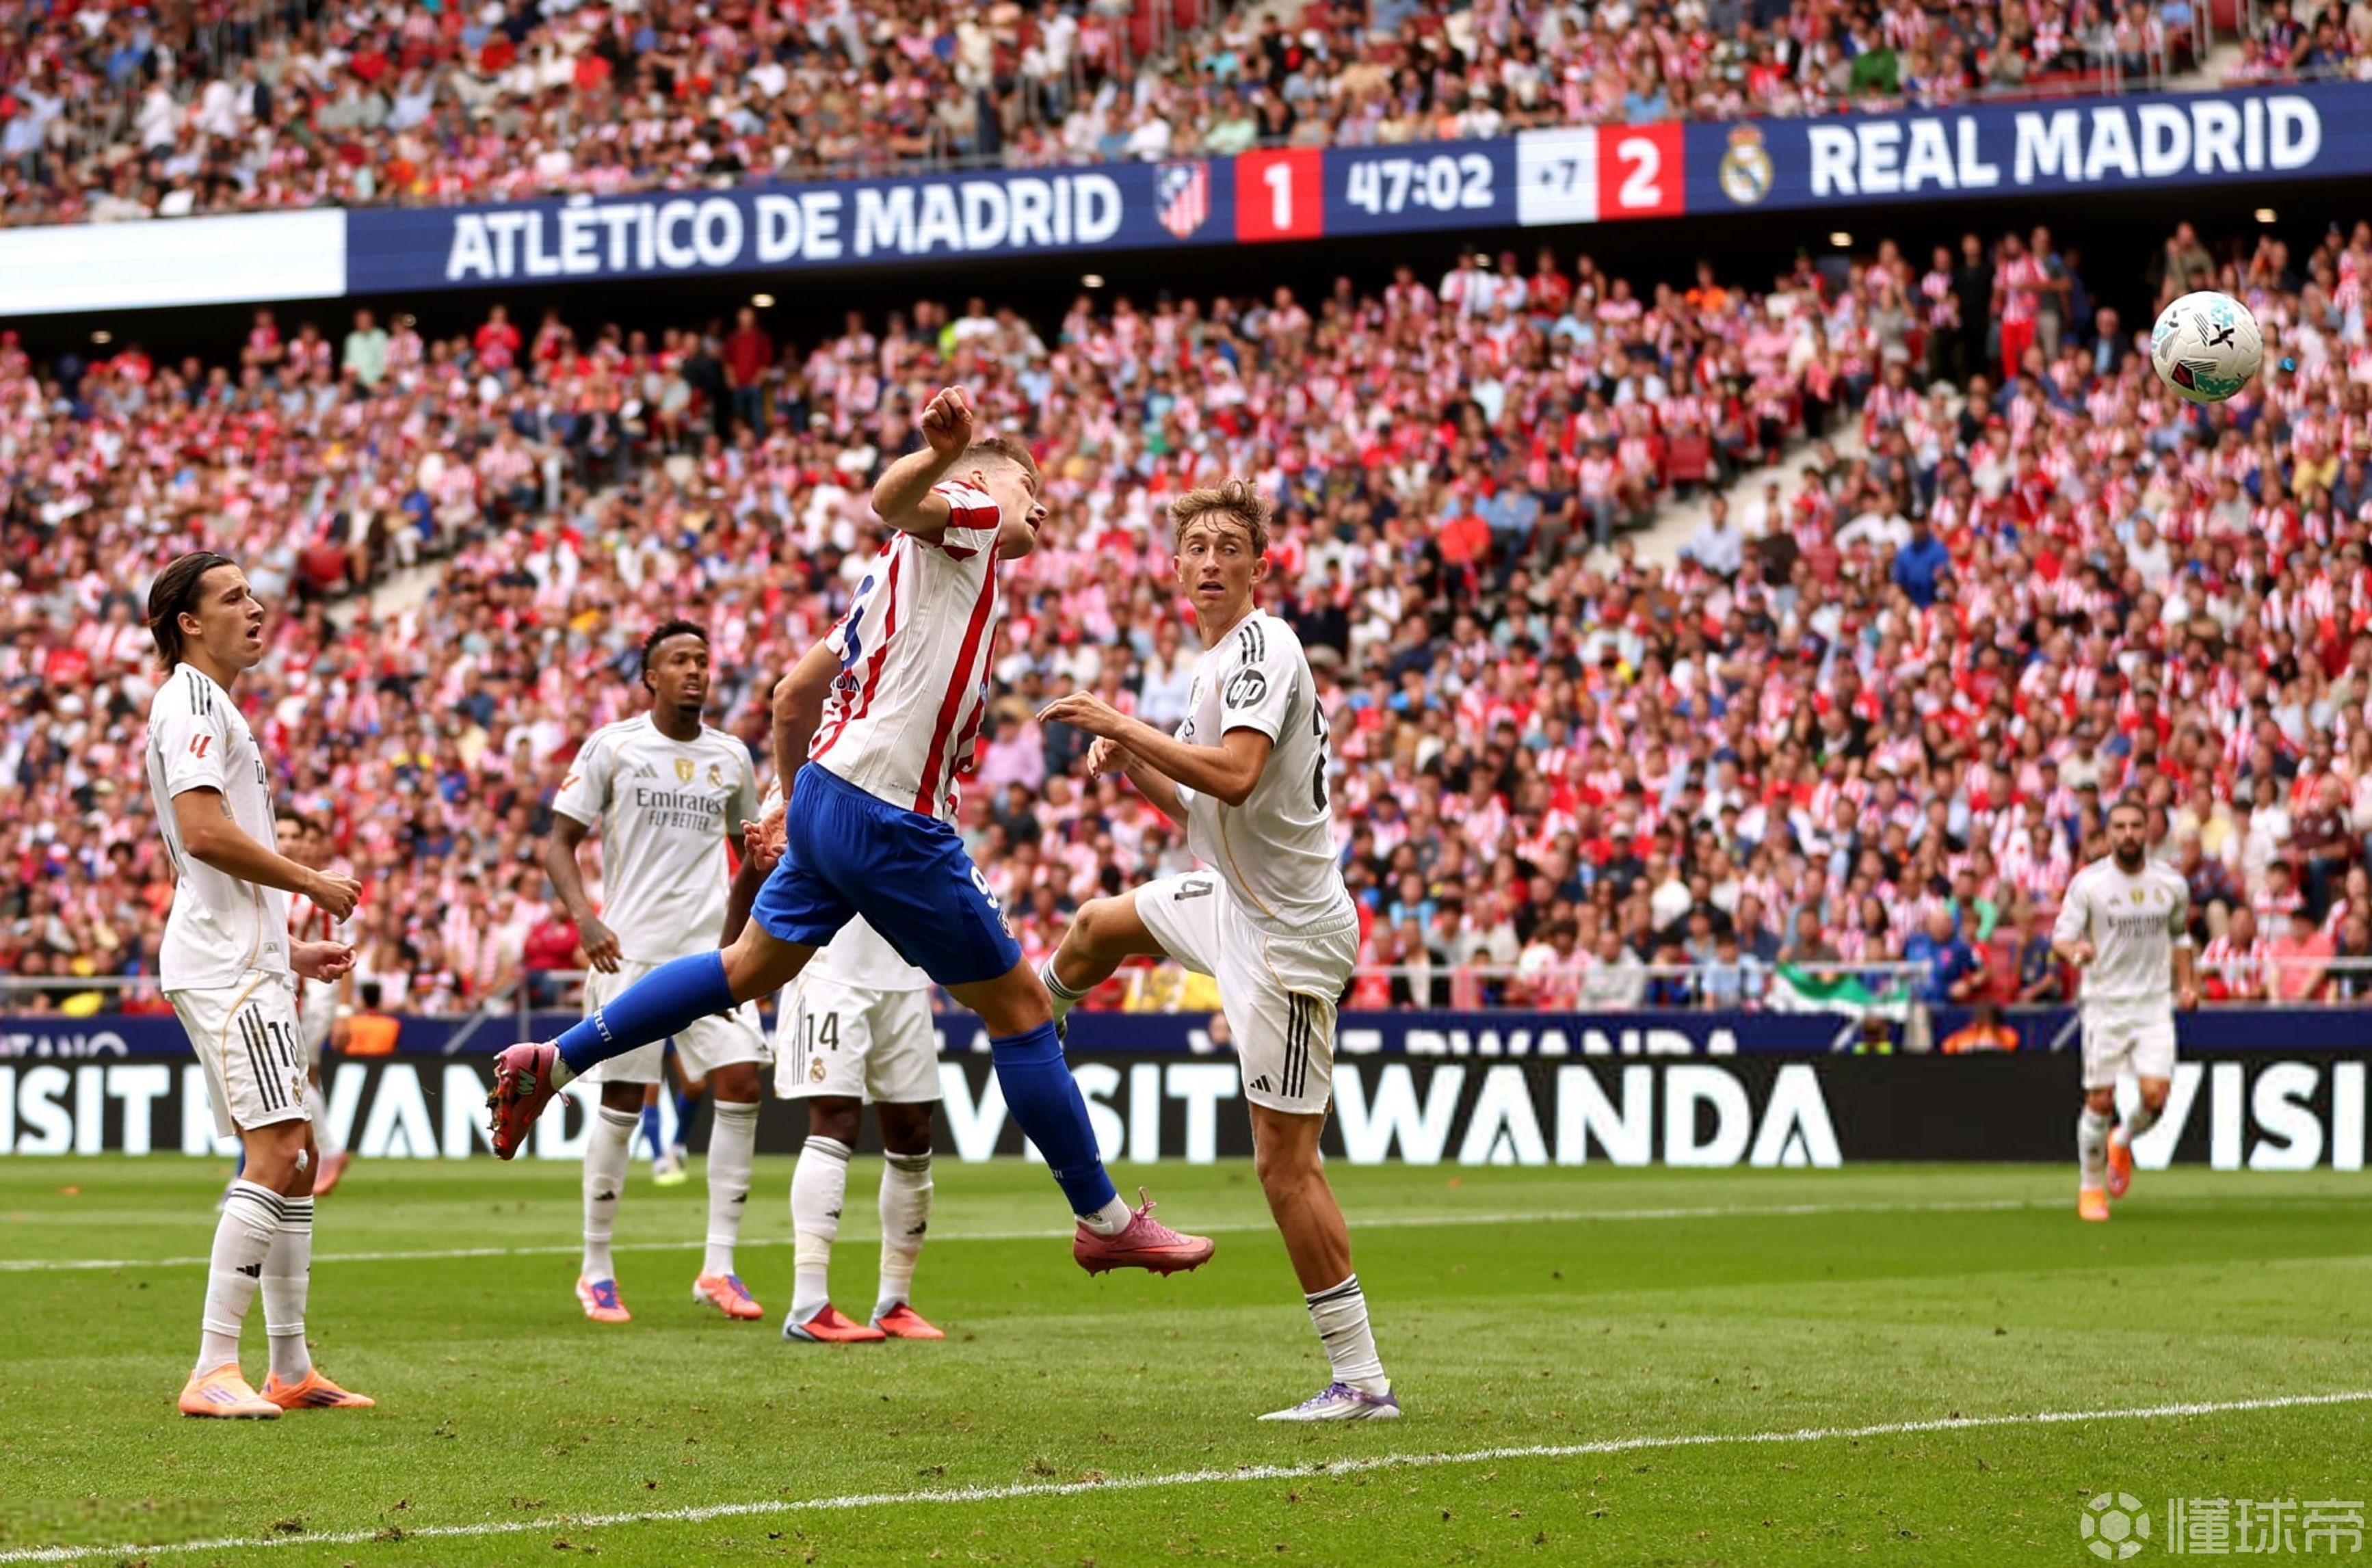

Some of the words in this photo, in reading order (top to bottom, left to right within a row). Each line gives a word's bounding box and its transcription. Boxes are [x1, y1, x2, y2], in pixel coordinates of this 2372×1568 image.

[1618, 138, 1661, 207] 2
[1808, 116, 1999, 196] REAL
[2014, 95, 2321, 184] MADRID
[1264, 163, 1291, 229] 1
[1347, 154, 1494, 214] 47:02
[447, 193, 743, 280] ATLÉTICO
[755, 191, 843, 262] DE
[854, 174, 1122, 256] MADRID
[637, 788, 722, 814] Emirates
[649, 810, 668, 826] FLY
[671, 812, 710, 832] BETTER
[971, 866, 998, 908] 9
[806, 1012, 839, 1052] 14
[938, 1061, 1239, 1165] VSIT
[1320, 1063, 1843, 1167] WANDA
